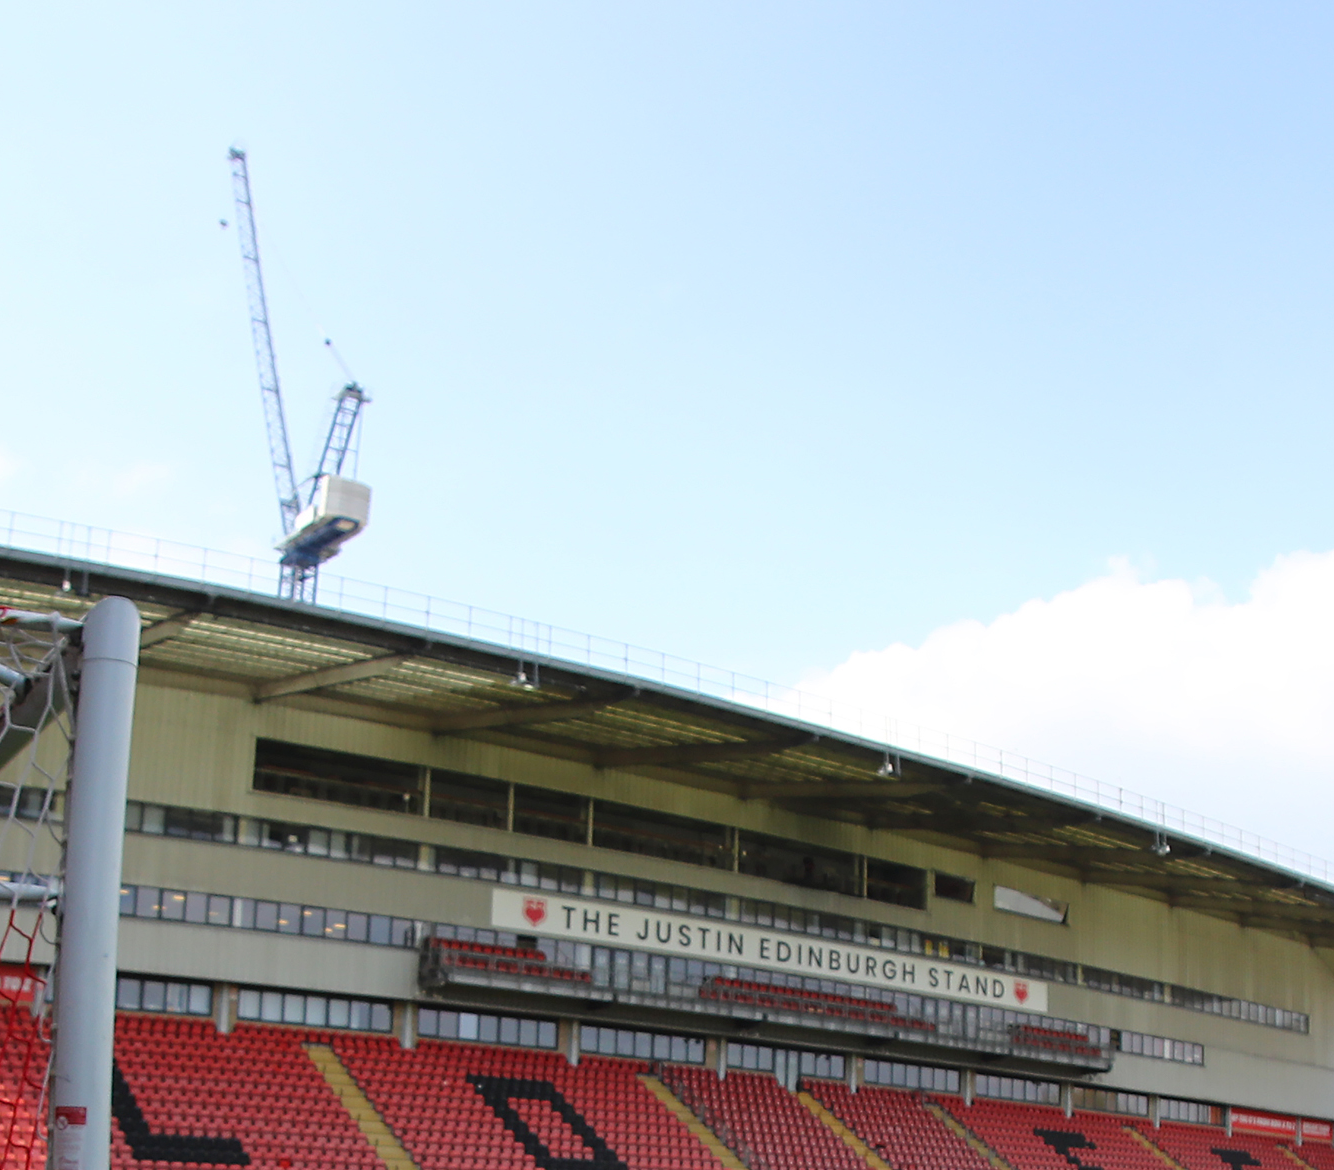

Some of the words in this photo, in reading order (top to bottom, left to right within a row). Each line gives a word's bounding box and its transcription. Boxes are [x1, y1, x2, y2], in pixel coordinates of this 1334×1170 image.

[561, 905, 620, 936] THE
[637, 918, 744, 955] JUSTIN
[760, 938, 915, 983] EDINBURGH
[929, 967, 1005, 998] STAND
